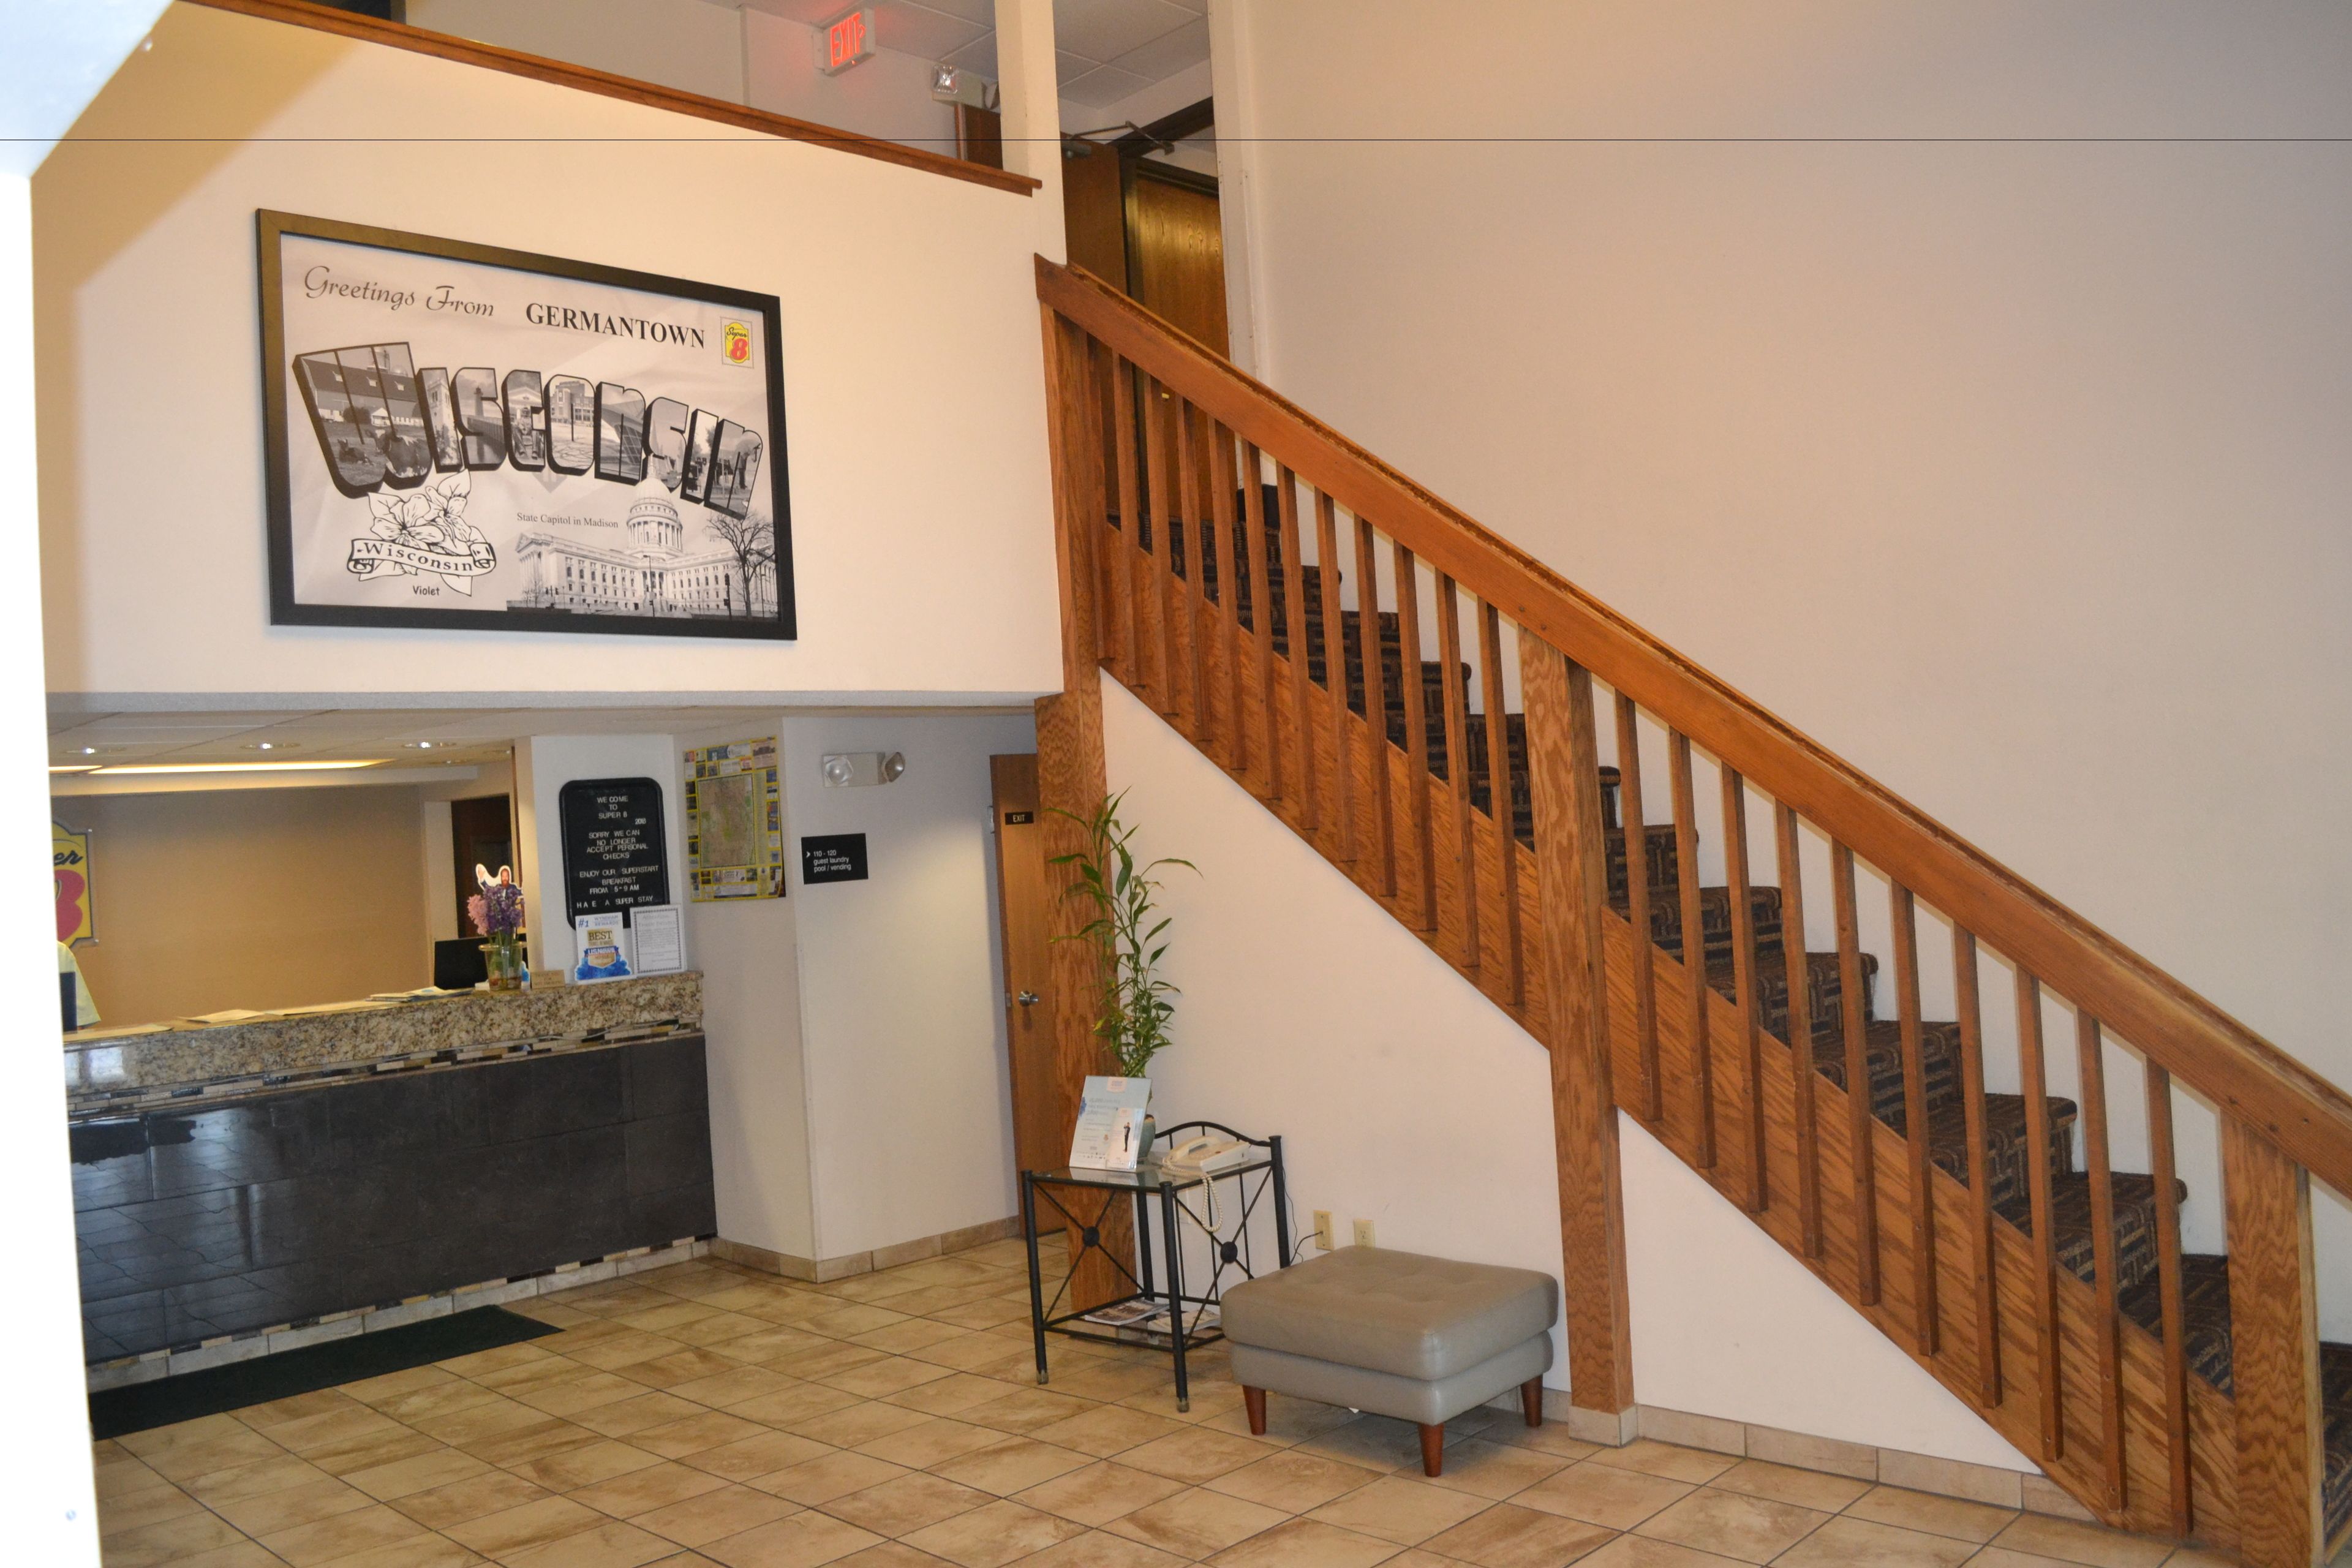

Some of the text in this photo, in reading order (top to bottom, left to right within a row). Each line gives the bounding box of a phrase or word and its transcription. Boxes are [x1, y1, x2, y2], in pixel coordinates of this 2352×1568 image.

[831, 12, 861, 67] EXIT
[304, 265, 494, 317] Greetings From
[526, 303, 705, 349] GERMANTOWN
[726, 326, 747, 341] Super
[730, 337, 748, 360] 8
[517, 512, 619, 528] State Capitol in Madison
[413, 585, 440, 596] Violet
[601, 876, 636, 886] BREAKFAST
[578, 918, 589, 928] #1
[588, 930, 612, 941] BEST
